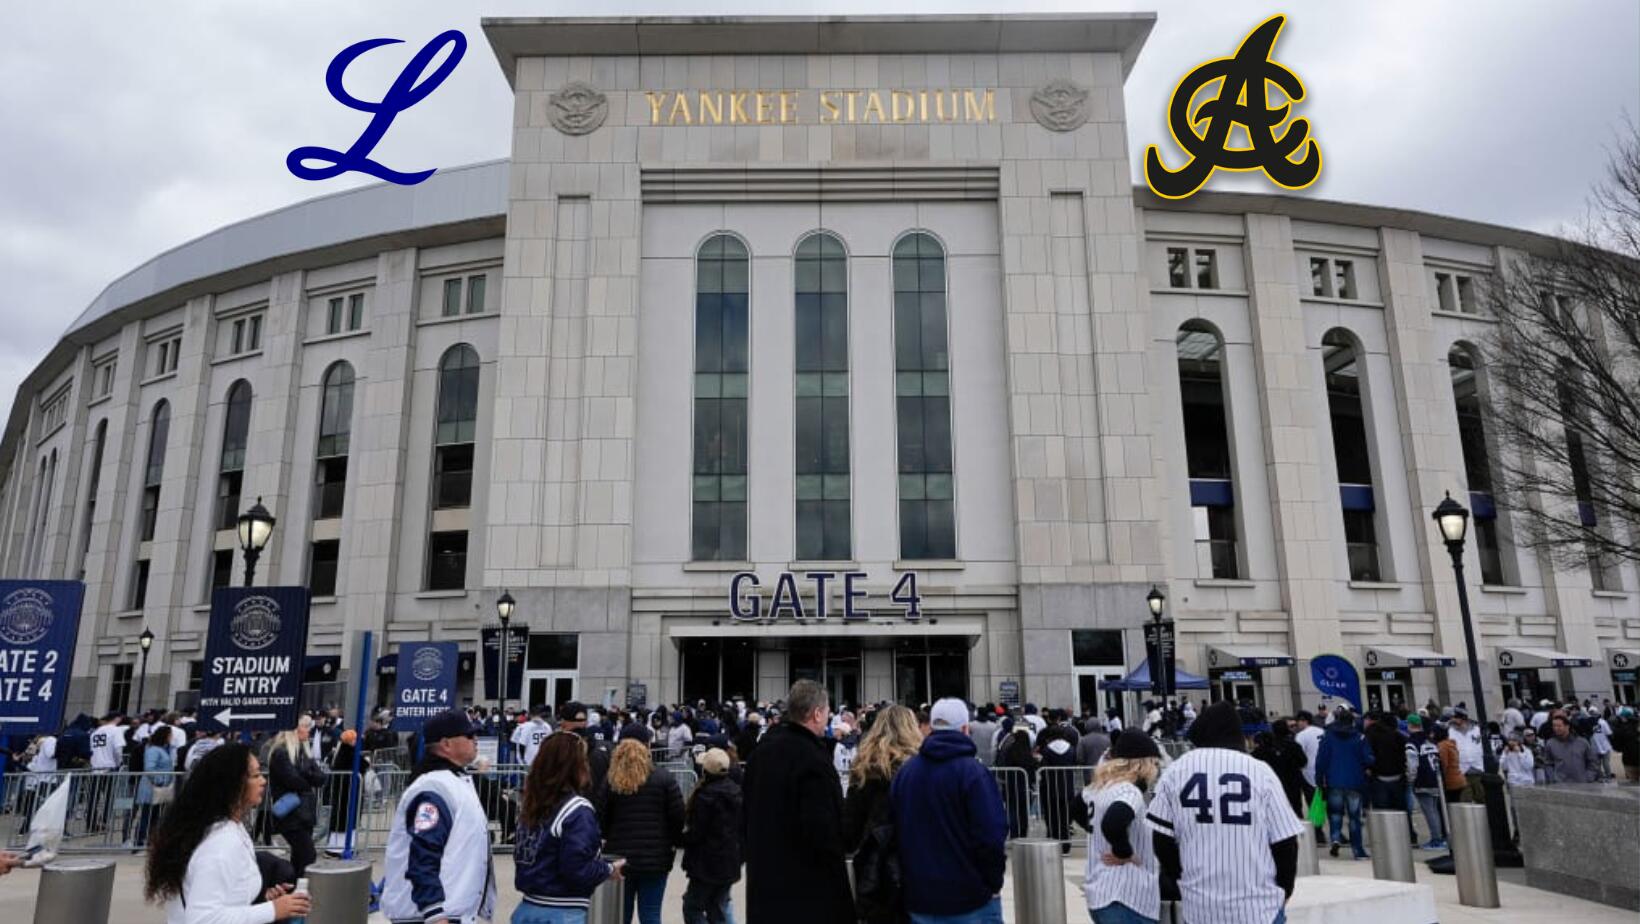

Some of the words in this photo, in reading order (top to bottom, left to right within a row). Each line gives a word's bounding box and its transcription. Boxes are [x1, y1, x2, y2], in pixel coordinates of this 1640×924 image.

[643, 90, 799, 126] YANKEE
[819, 88, 996, 125] STADIUM
[729, 571, 872, 621] GATE
[890, 571, 922, 619] 4
[42, 650, 58, 673] 2
[212, 656, 290, 675] STADIUM
[0, 677, 33, 702] TE
[38, 679, 53, 702] 4
[223, 676, 281, 695] ENTRY
[401, 688, 437, 703] GATE
[439, 688, 448, 703] 4
[396, 706, 426, 717] ENTER
[1179, 773, 1252, 826] 42
